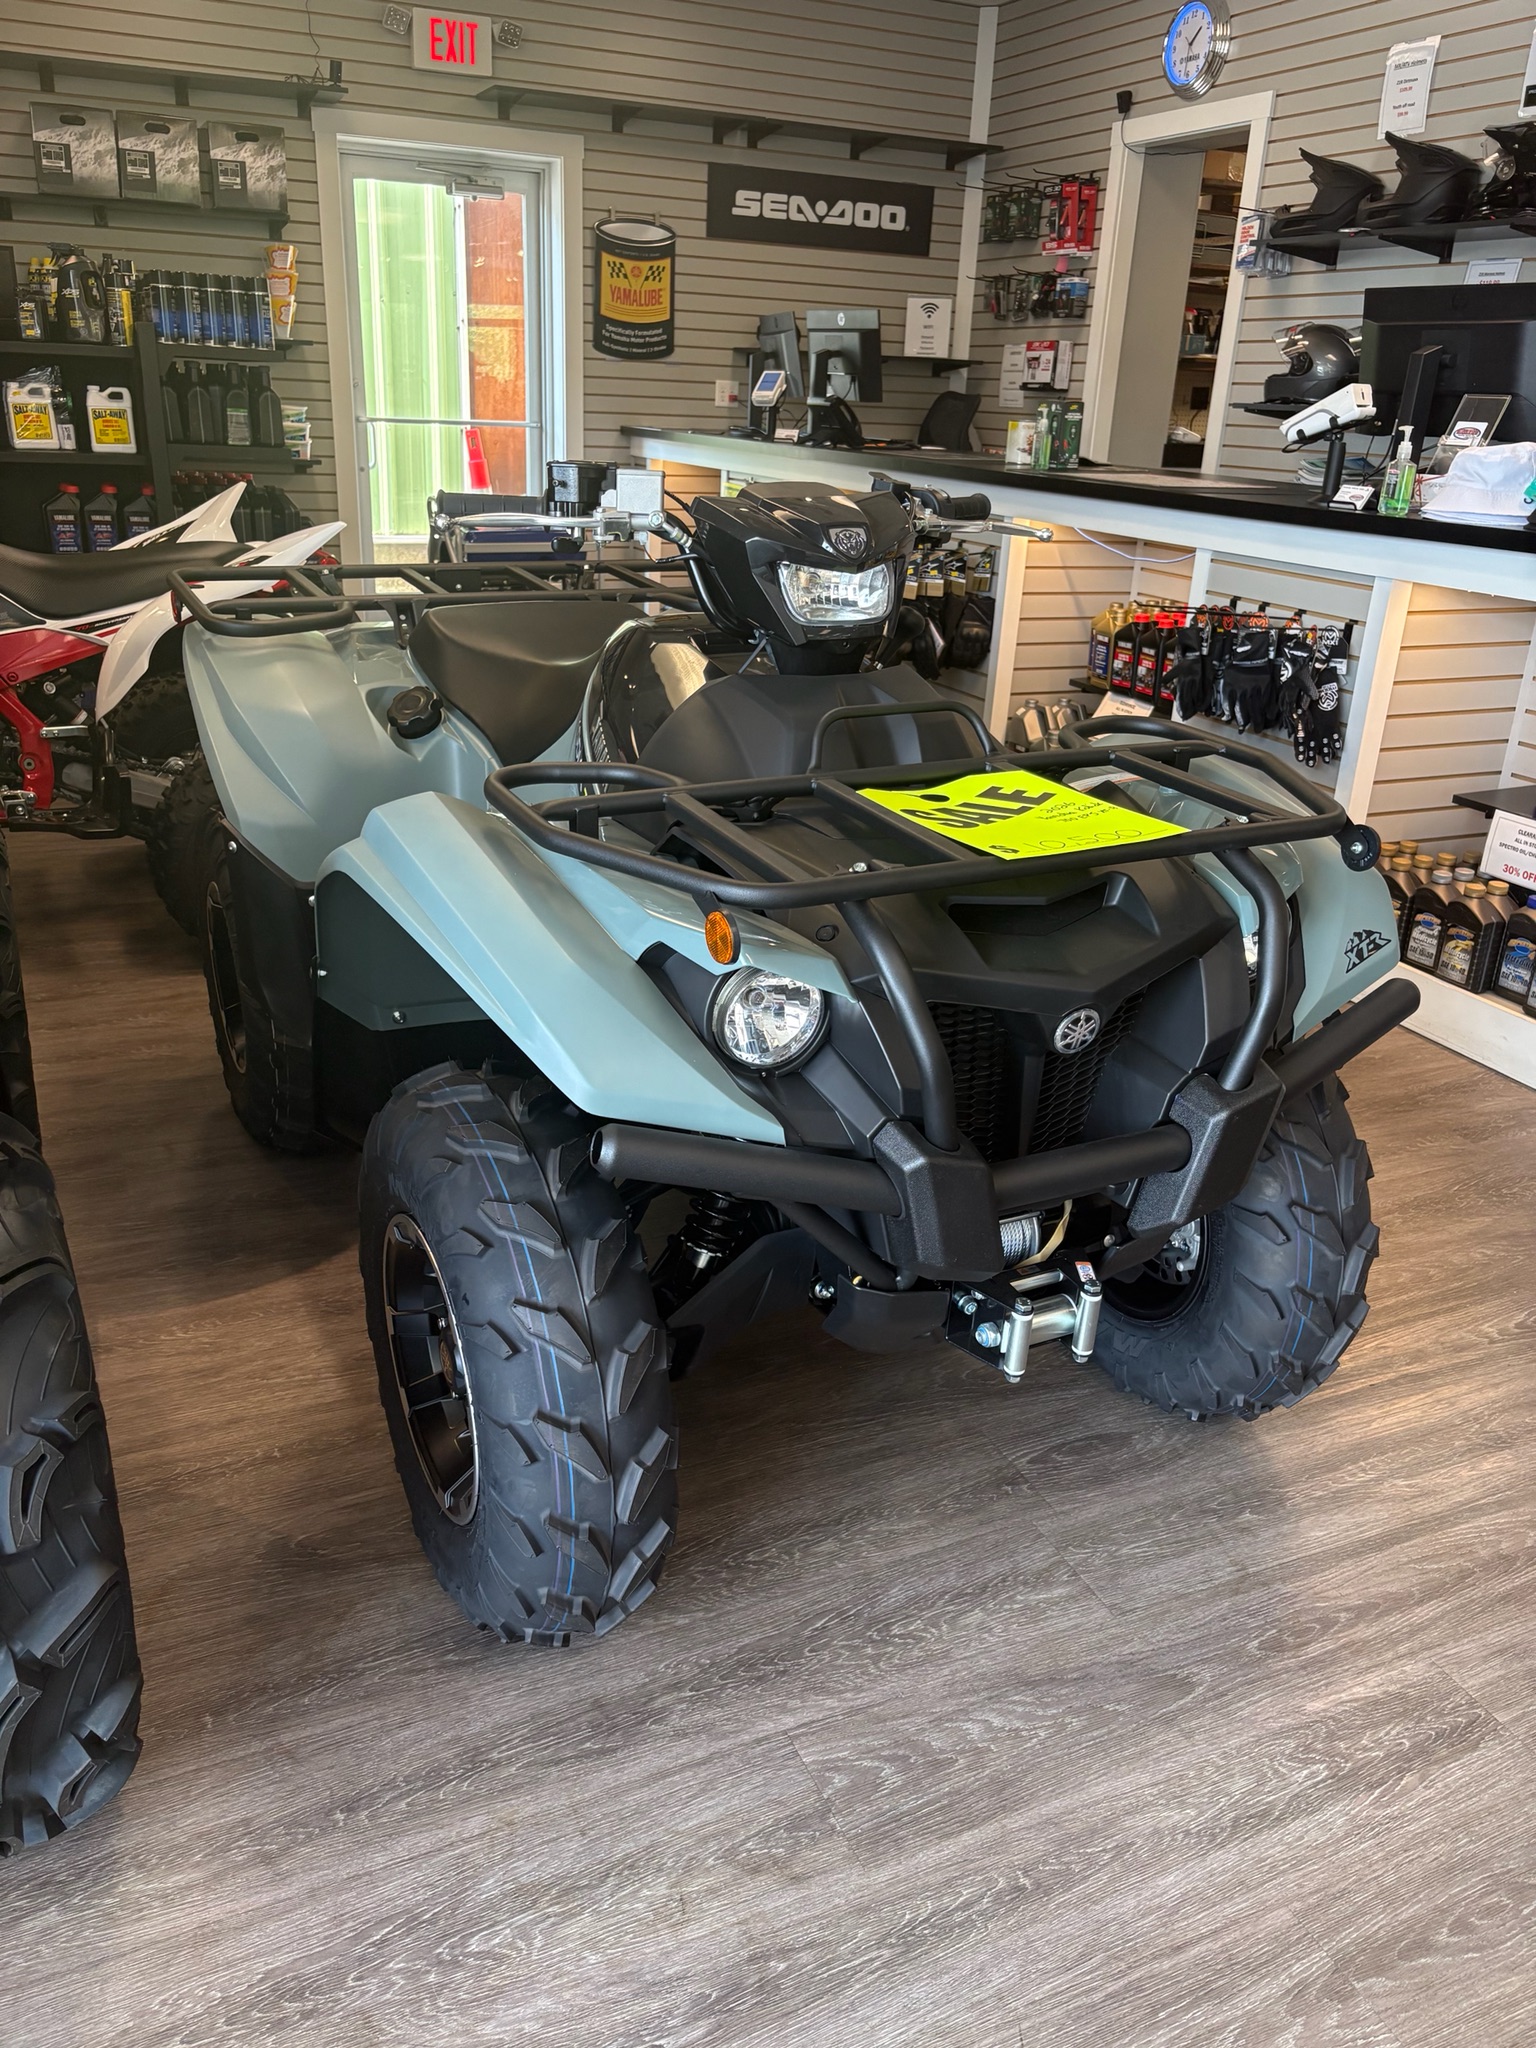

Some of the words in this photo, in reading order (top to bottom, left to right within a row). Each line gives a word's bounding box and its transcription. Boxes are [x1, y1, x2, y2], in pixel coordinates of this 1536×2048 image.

[1191, 9, 1198, 19] 12
[1183, 17, 1190, 26] 11
[429, 17, 478, 66] EXIT
[610, 284, 663, 308] YAMALUBE
[602, 329, 611, 338] For
[611, 332, 630, 343] Yamaha
[630, 336, 645, 344] Motor
[645, 334, 668, 343] Products
[605, 323, 635, 337] Specifically
[635, 327, 663, 336] Formulated
[92, 409, 127, 420] SALT-AWAY
[899, 785, 1057, 829] SALE
[1040, 802, 1076, 814] 2026
[1498, 842, 1519, 853] SPECTRO
[1514, 837, 1523, 845] ALL
[1502, 863, 1520, 877] 30%
